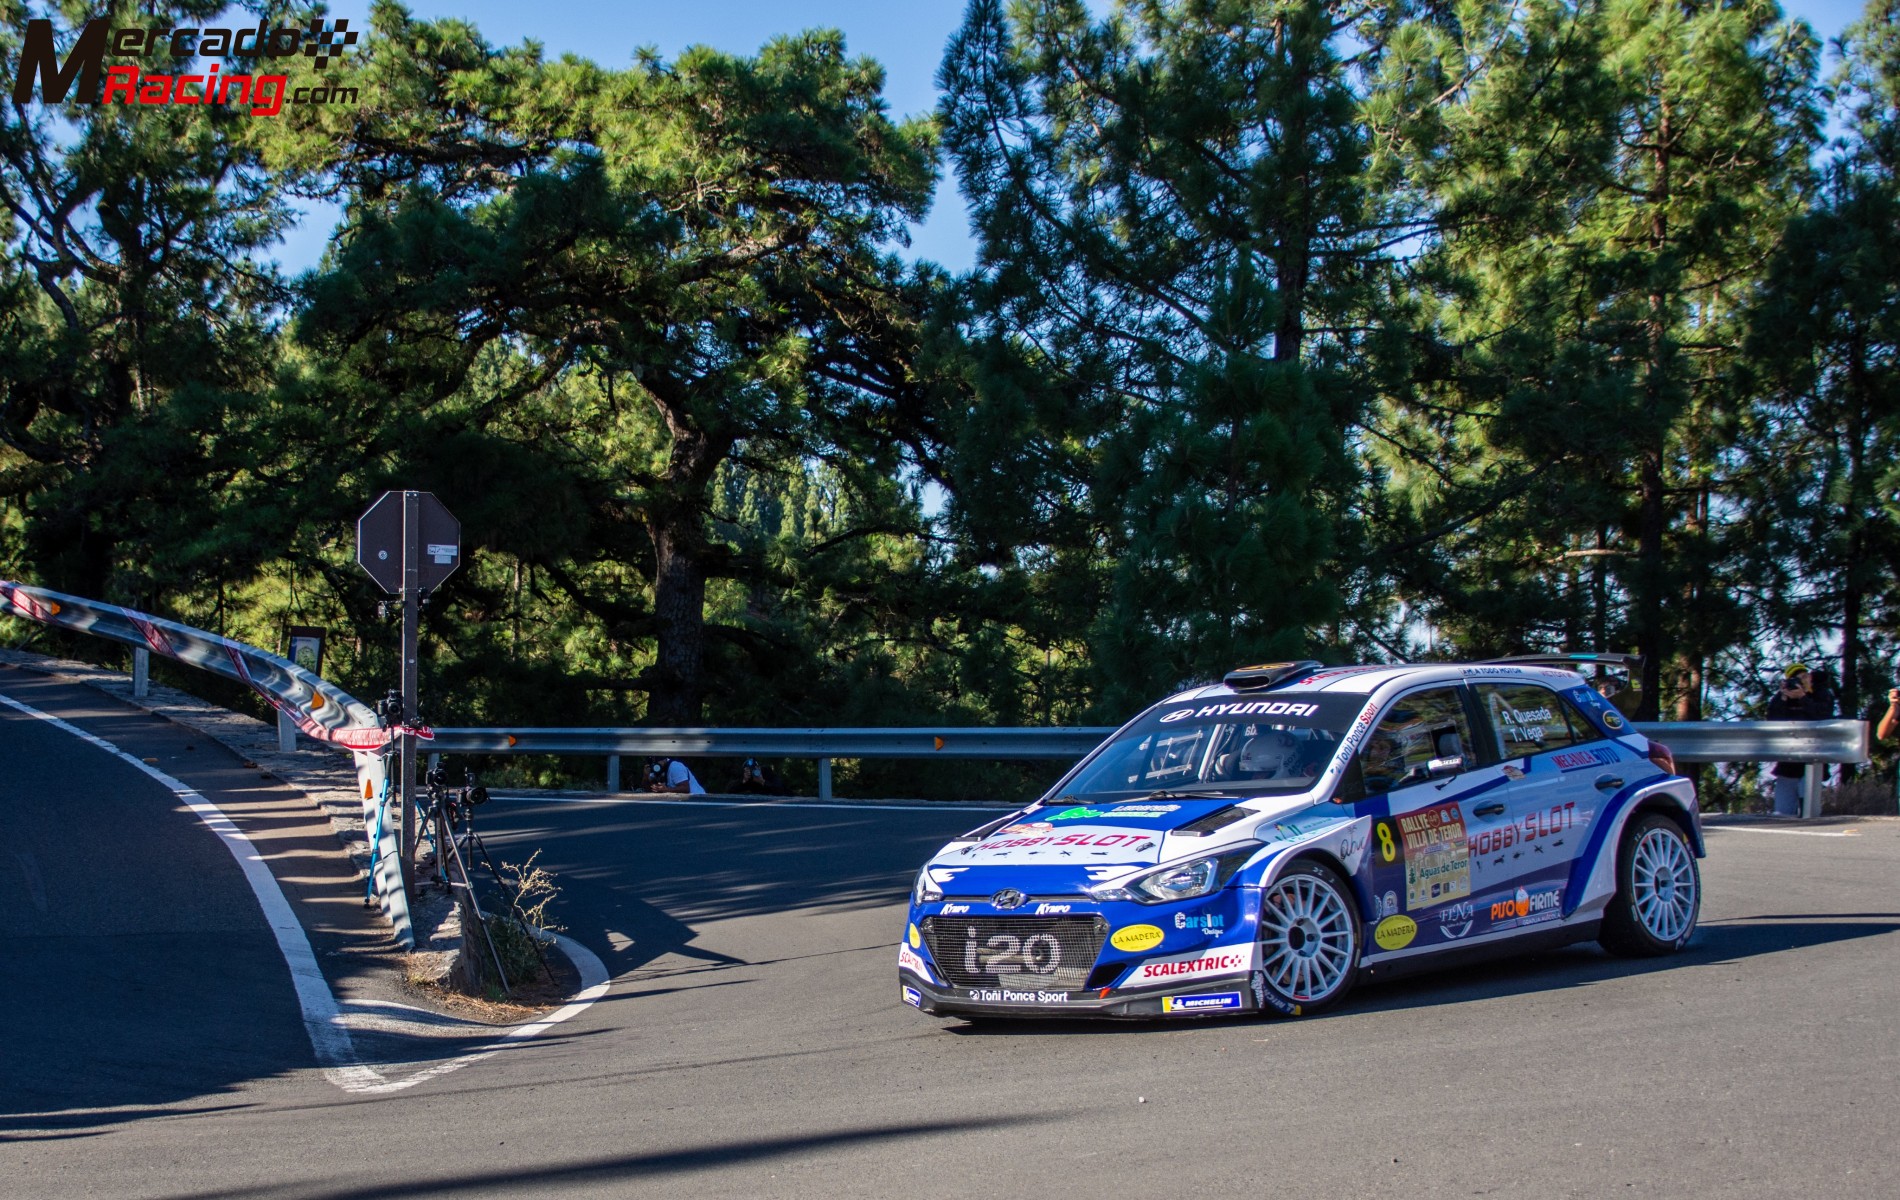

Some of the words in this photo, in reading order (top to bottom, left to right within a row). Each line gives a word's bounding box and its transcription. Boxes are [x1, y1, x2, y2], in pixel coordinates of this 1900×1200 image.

[1195, 702, 1320, 718] HYUNDAI
[1502, 711, 1514, 725] R.
[1515, 706, 1553, 724] Quesada
[1346, 722, 1366, 747] Ponce
[1359, 702, 1378, 725] Sport
[1509, 729, 1520, 743] T.
[1520, 726, 1543, 742] Vega
[1589, 747, 1621, 766] SOTO
[1400, 813, 1430, 833] RALLYE
[1377, 822, 1396, 862] 8
[1406, 830, 1428, 849] VILLA
[1428, 828, 1439, 844] DE
[1438, 823, 1463, 842] TEROR
[1419, 866, 1440, 880] Aguas
[1440, 862, 1449, 873] de
[1449, 859, 1468, 871] Teror
[1529, 890, 1560, 911] FIRME
[1439, 901, 1474, 922] FINA
[1113, 936, 1124, 944] LA
[1125, 932, 1161, 942] MADERA
[1376, 930, 1386, 940] LA
[1386, 924, 1415, 937] MADERA
[965, 926, 1062, 974] i20
[1144, 955, 1229, 978] SCALEXTRIC
[980, 989, 1001, 1001] Toñi
[1003, 989, 1036, 1001] Ponce
[1037, 990, 1068, 1003] Sport
[1184, 997, 1233, 1007] MICHELIN
